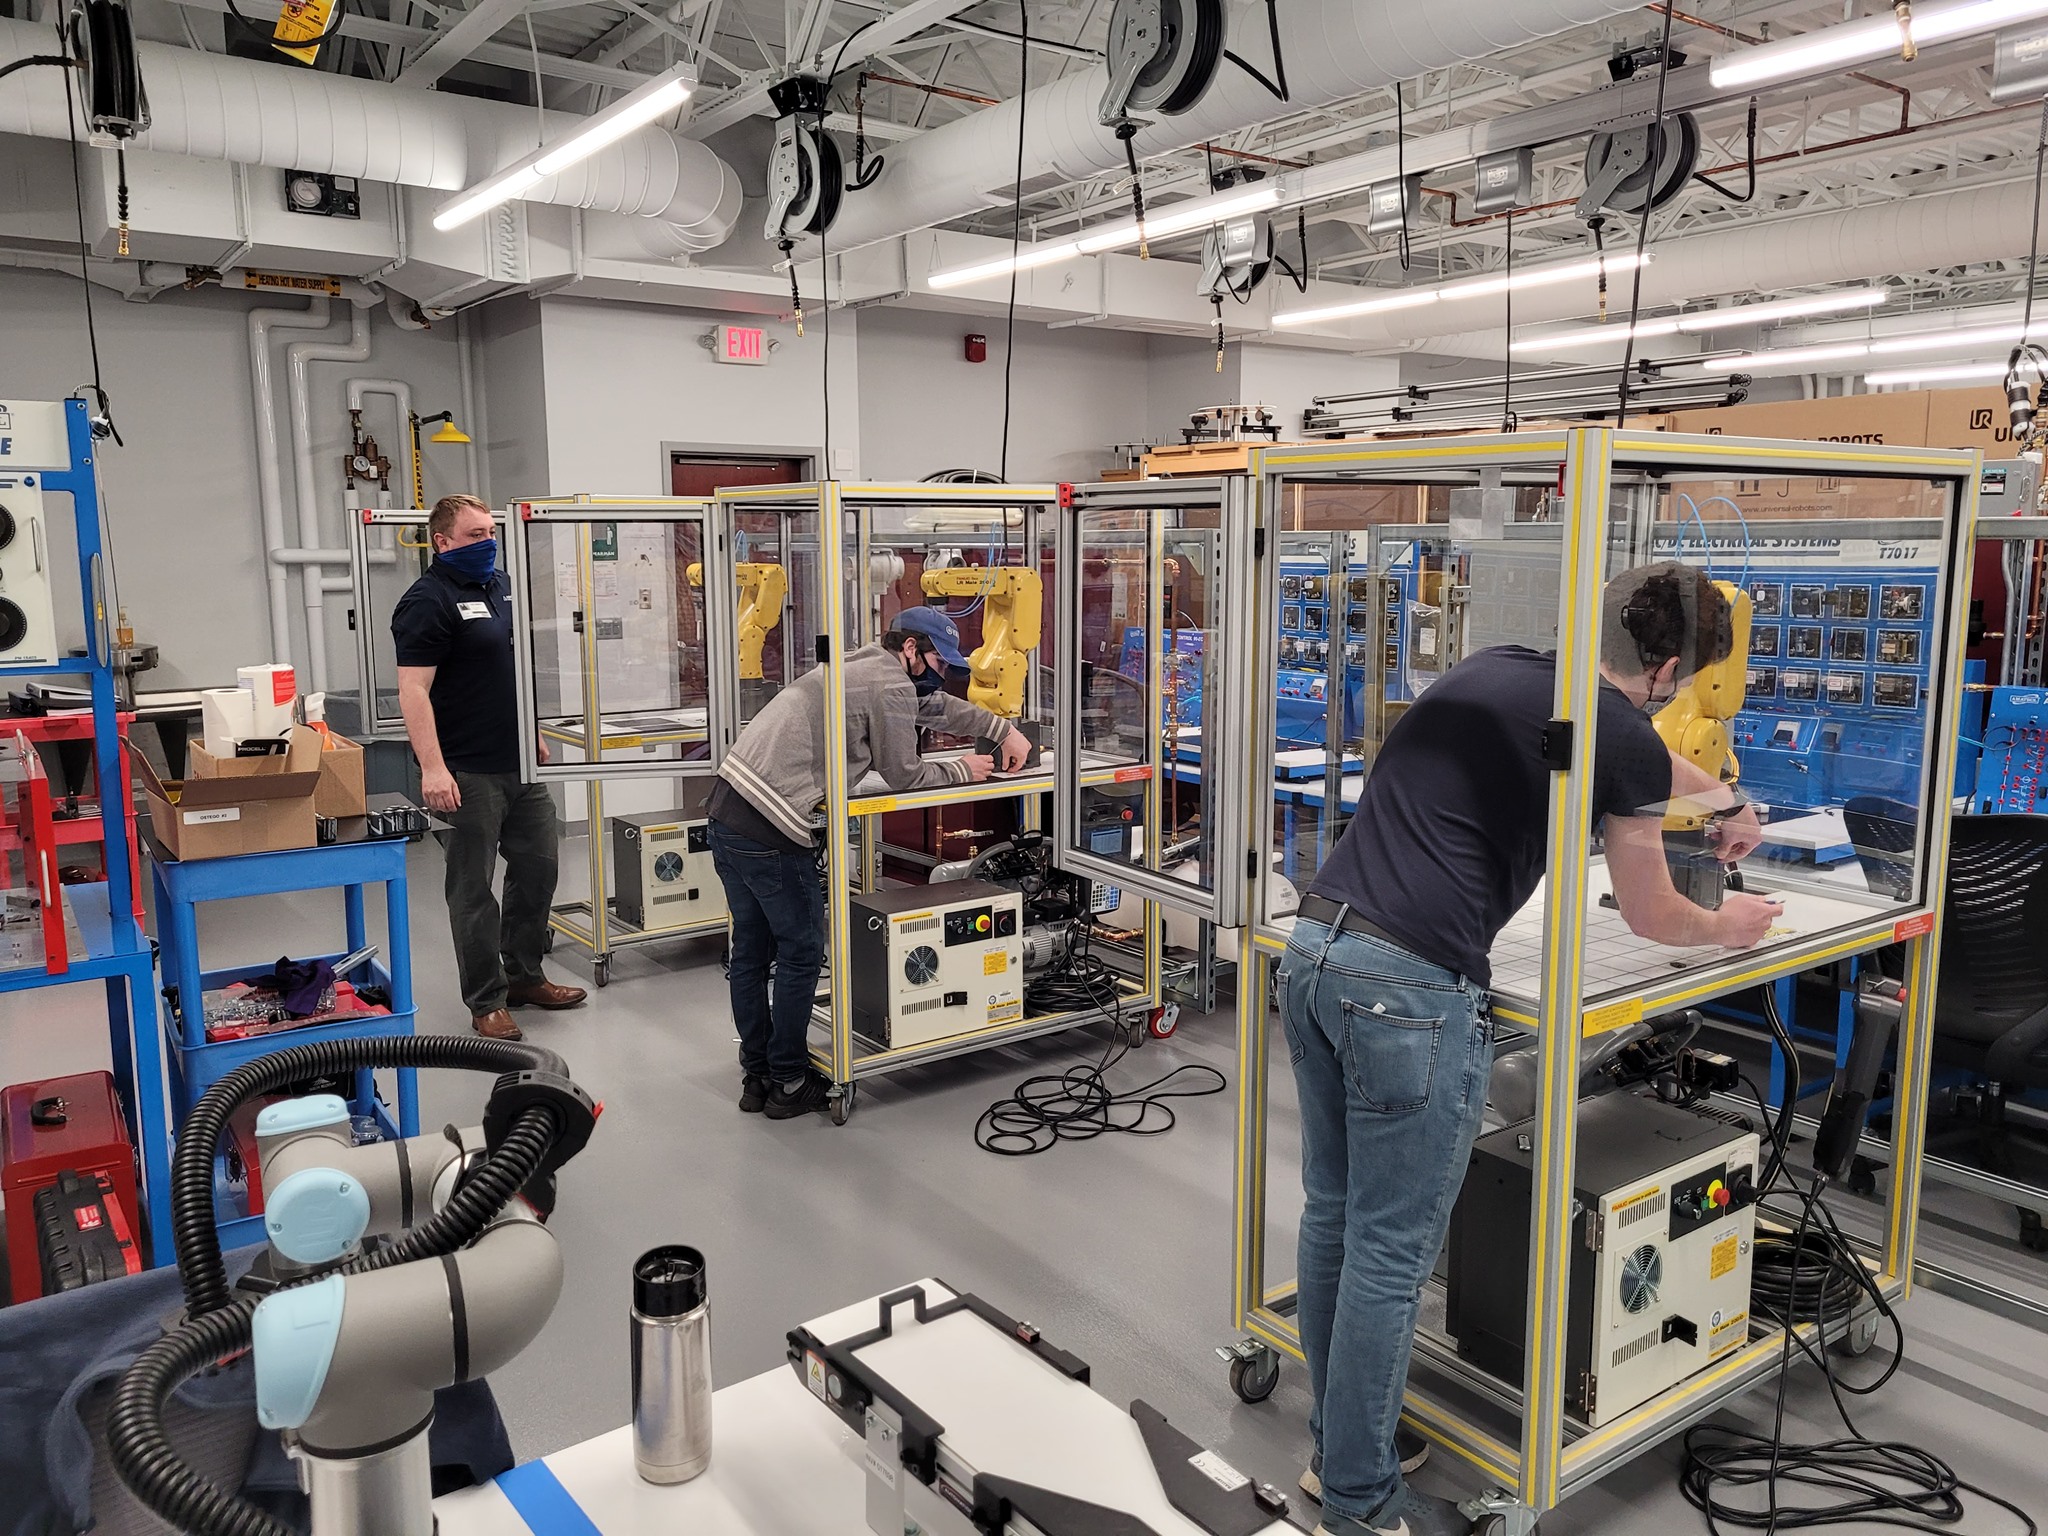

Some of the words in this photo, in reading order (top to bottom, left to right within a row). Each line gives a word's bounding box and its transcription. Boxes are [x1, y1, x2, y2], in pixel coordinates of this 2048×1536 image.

[259, 274, 279, 286] HEATING
[280, 276, 290, 287] HOT
[292, 277, 307, 289] WATER
[308, 279, 325, 290] SUPPLY
[727, 327, 762, 359] EXIT
[414, 452, 423, 504] SPEAKMAN
[1742, 504, 1833, 513] www.universal-robots.com
[1879, 547, 1919, 559] T7017
[1612, 1200, 1628, 1212] FANUC
